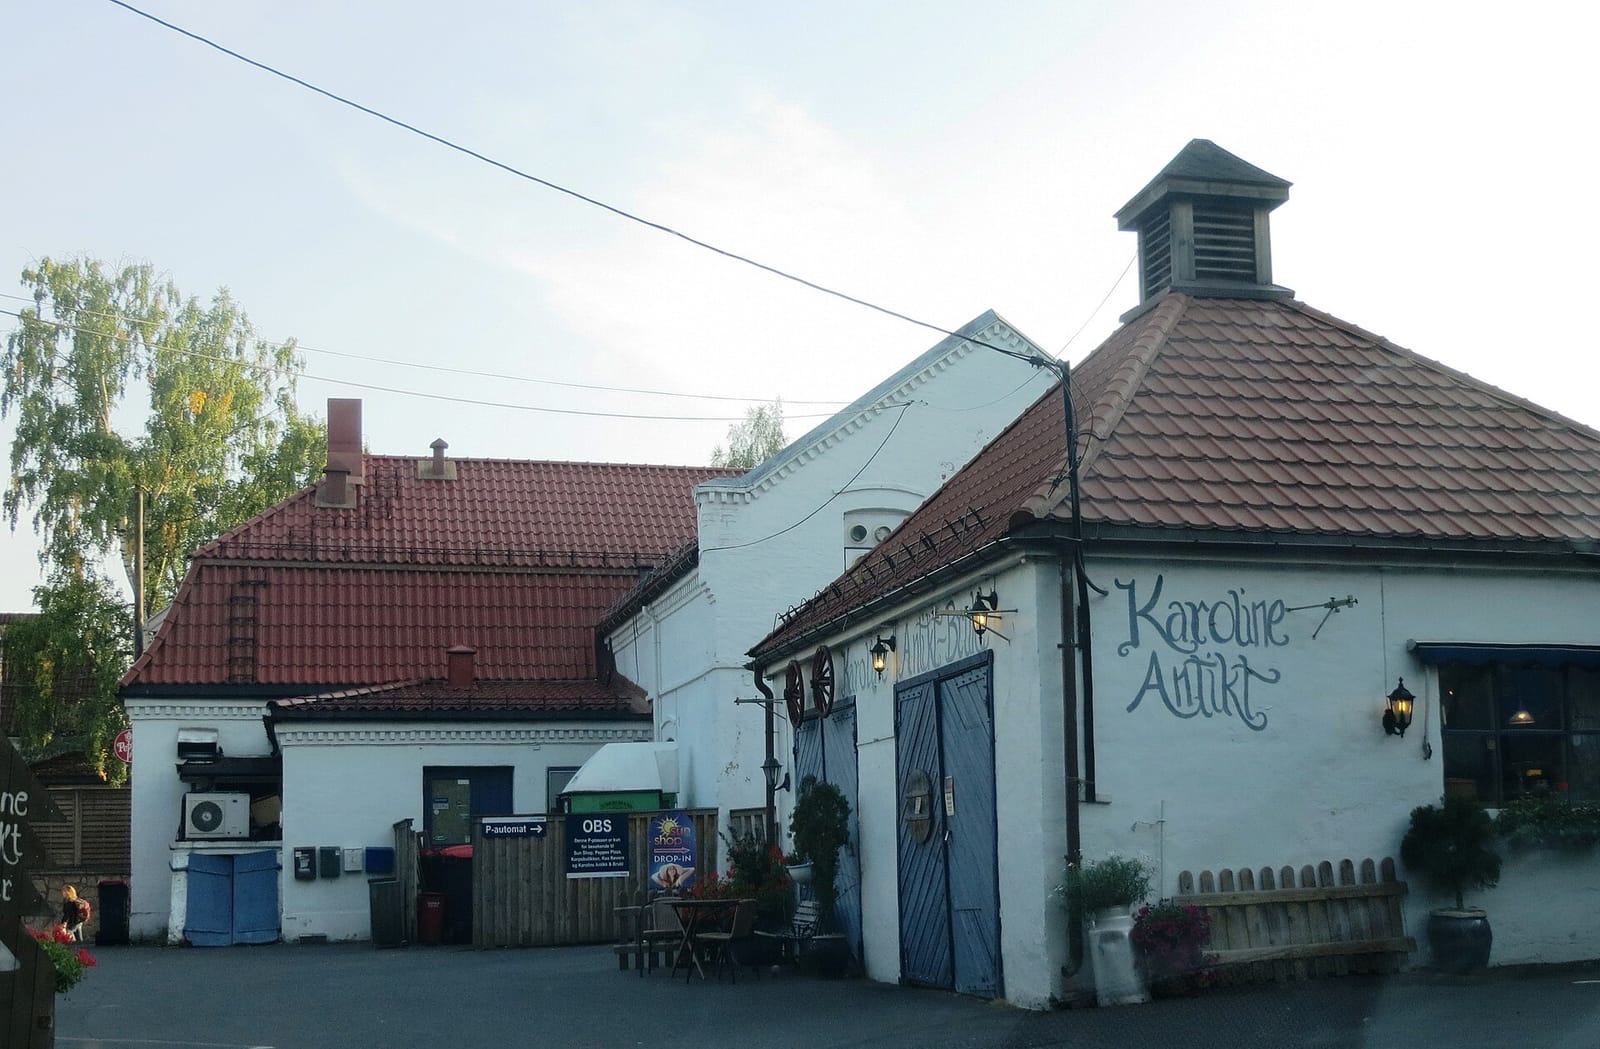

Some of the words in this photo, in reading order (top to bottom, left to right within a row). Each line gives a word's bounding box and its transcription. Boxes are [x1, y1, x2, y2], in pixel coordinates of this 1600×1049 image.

[1114, 574, 1289, 656] Karoline
[1126, 650, 1280, 731] Antikt
[485, 825, 527, 834] P-automat
[582, 819, 612, 833] OBS
[670, 827, 691, 836] sun
[654, 835, 682, 846] shop
